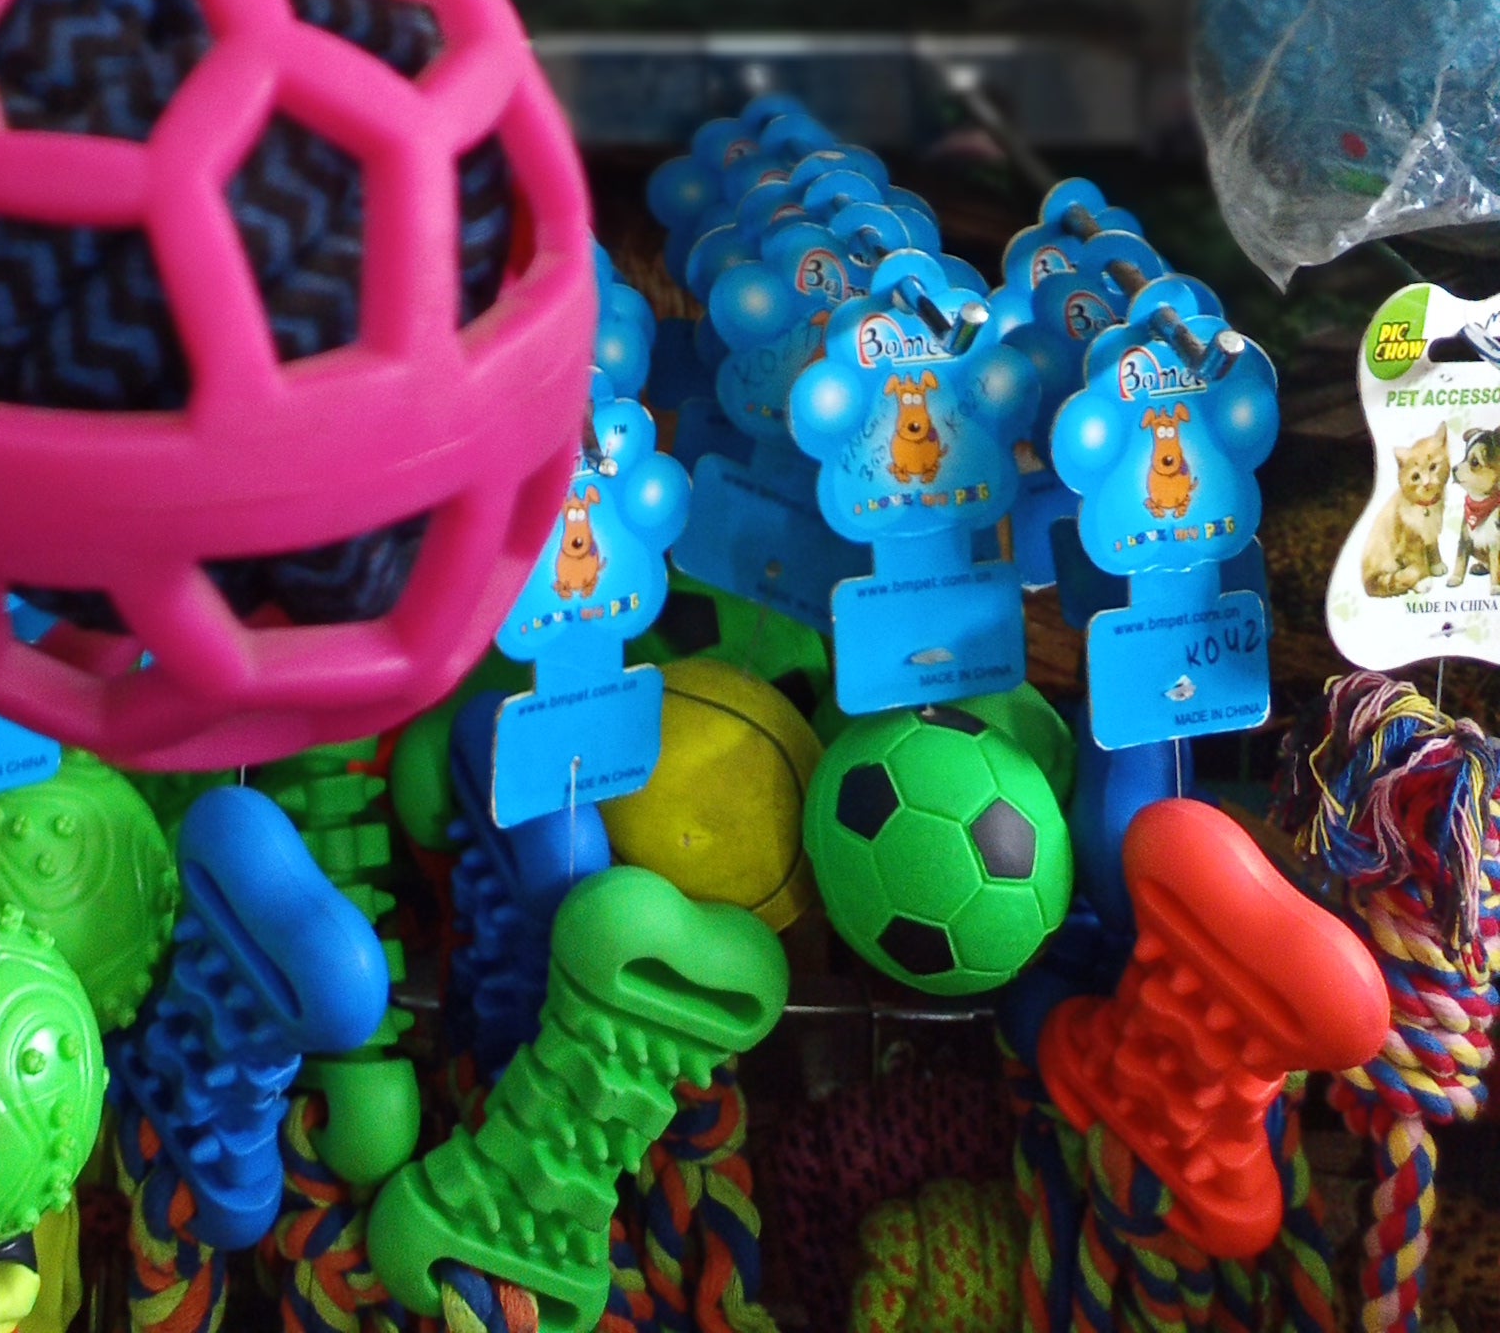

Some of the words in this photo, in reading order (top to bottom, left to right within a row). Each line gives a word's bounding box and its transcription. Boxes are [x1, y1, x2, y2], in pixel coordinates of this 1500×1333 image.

[1379, 320, 1411, 342] PIC
[1373, 339, 1428, 363] CHOW
[1385, 389, 1421, 409] PET
[1406, 600, 1441, 614] MADE
[1444, 599, 1458, 613] IN
[1460, 598, 1499, 612] CHINA
[1112, 606, 1242, 636] www.bmpet.com.cn
[918, 669, 956, 687] MADE
[958, 668, 972, 682] IN
[973, 663, 1013, 679] CHINA
[1174, 711, 1209, 726] MADE
[1210, 708, 1224, 721] IN
[1225, 702, 1263, 719] CHINA
[6, 754, 49, 775] CHINA
[597, 774, 610, 786] IN
[612, 765, 648, 782] CHINA
